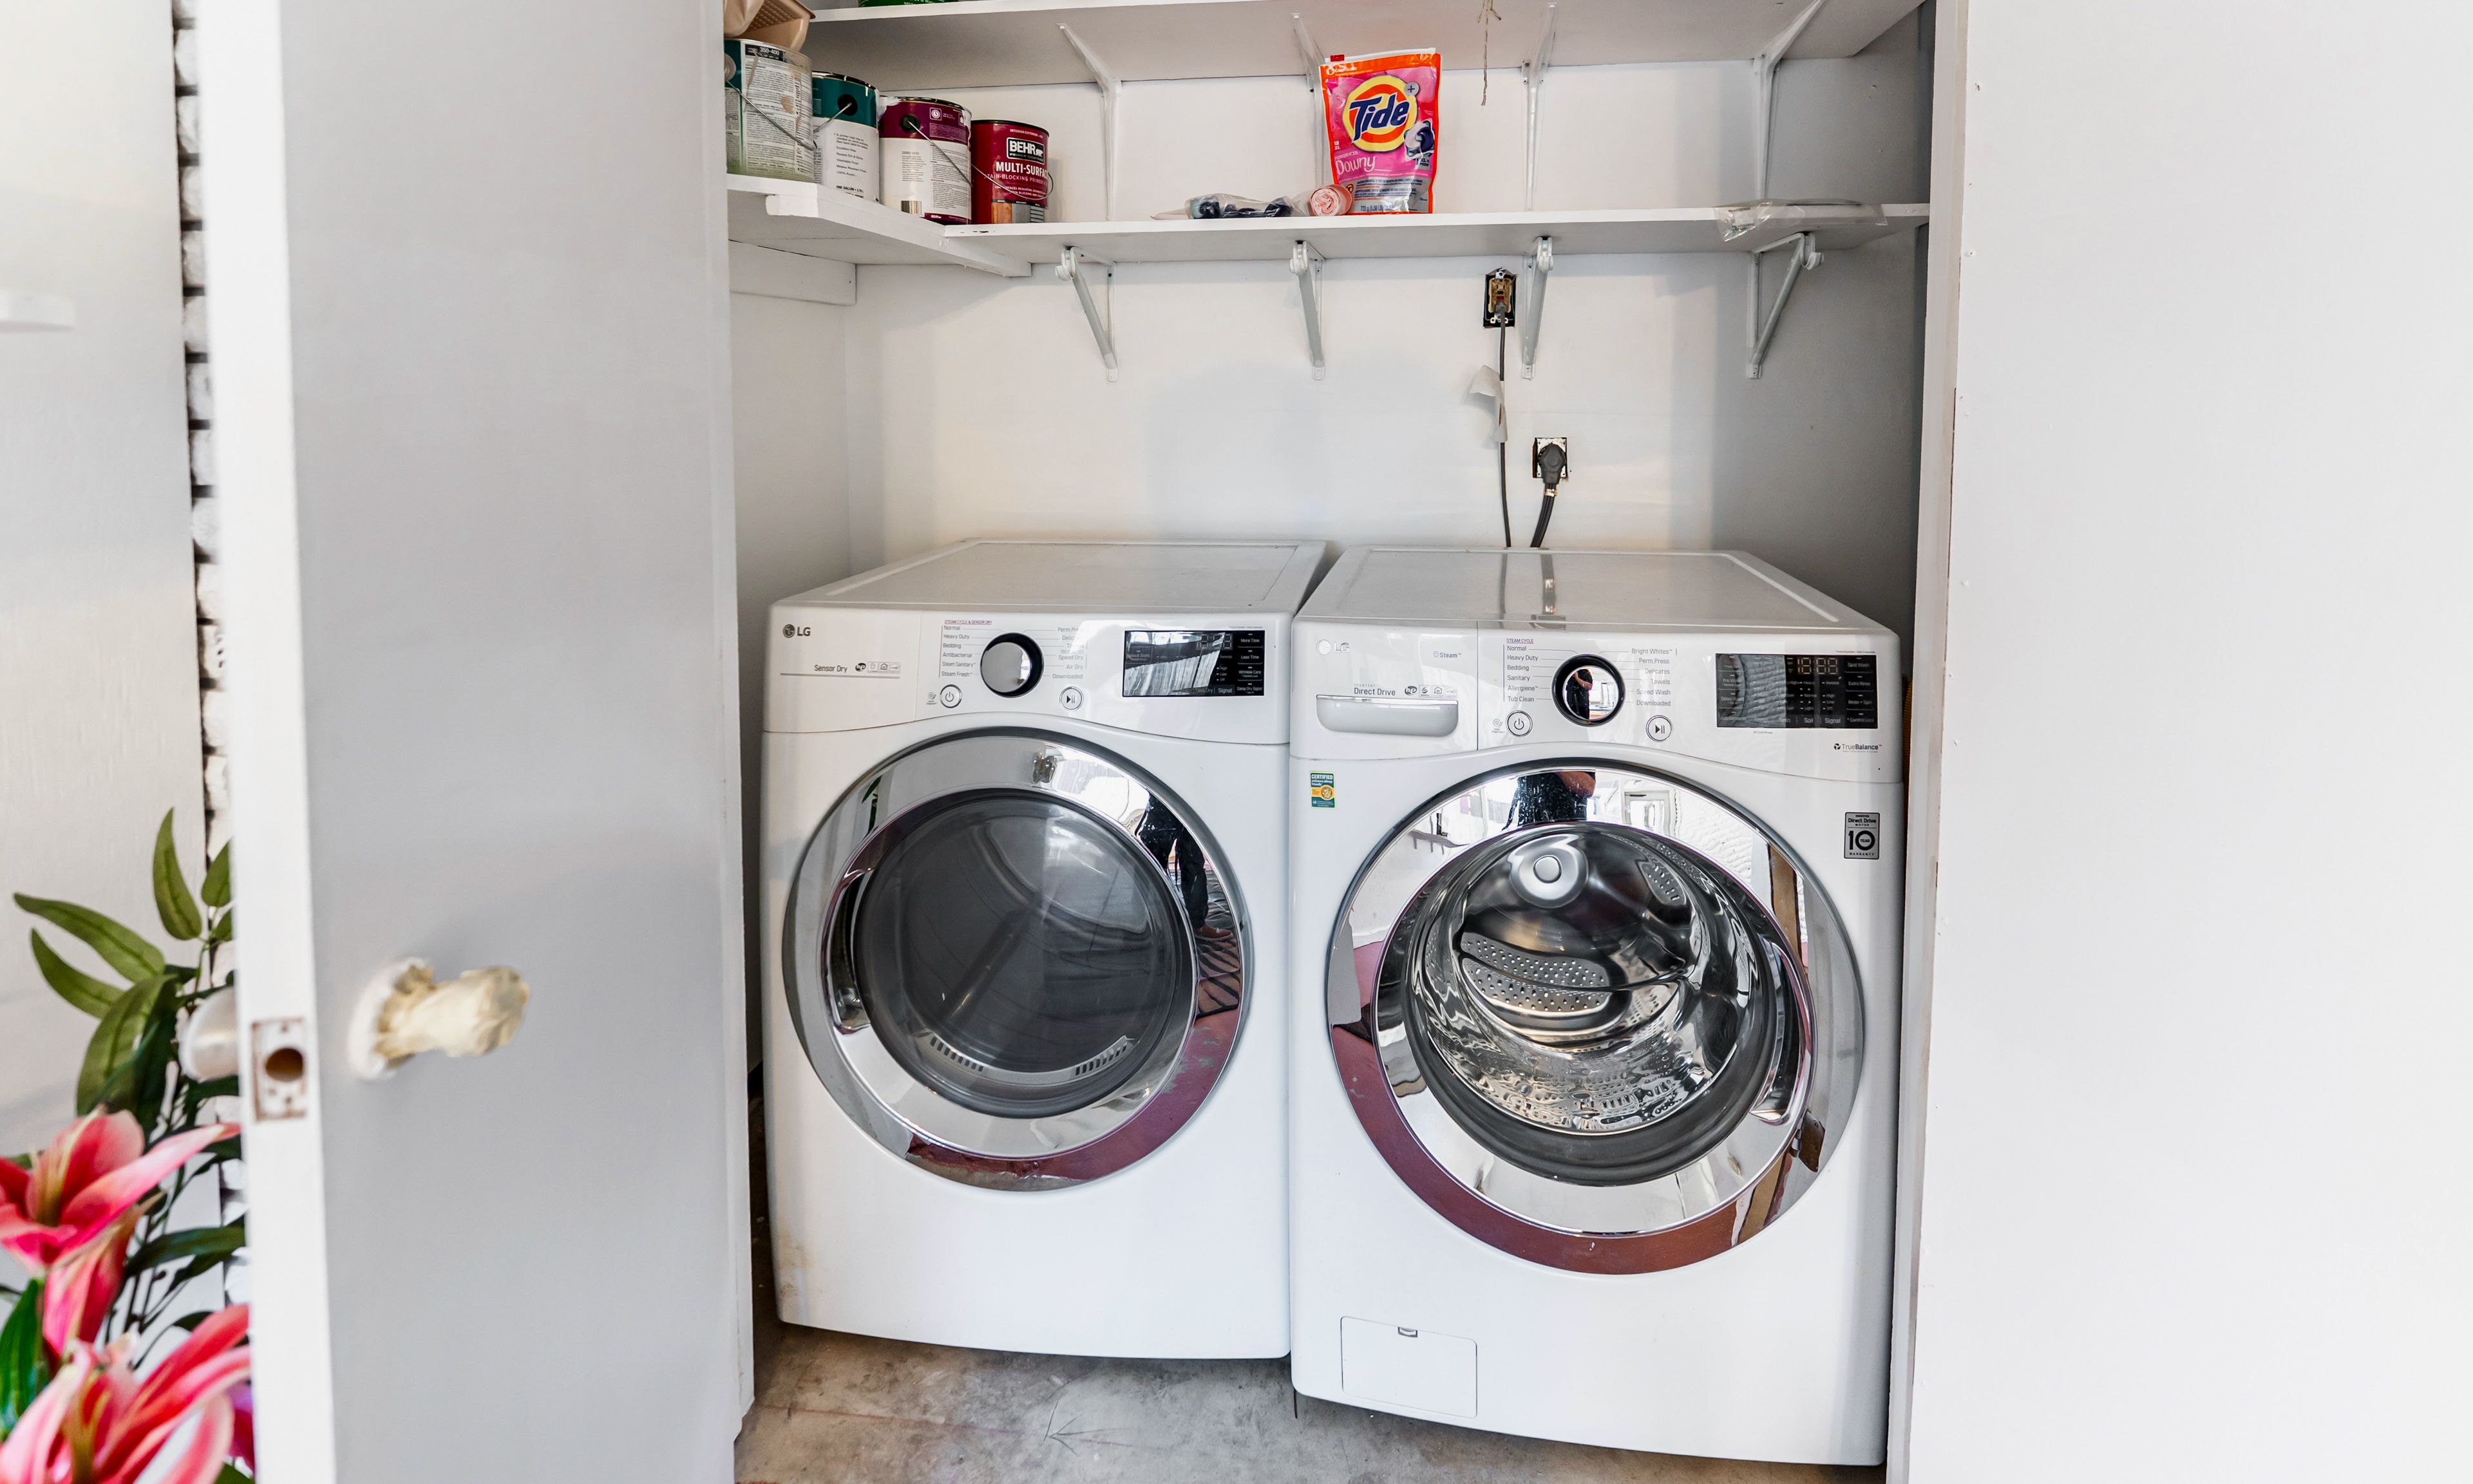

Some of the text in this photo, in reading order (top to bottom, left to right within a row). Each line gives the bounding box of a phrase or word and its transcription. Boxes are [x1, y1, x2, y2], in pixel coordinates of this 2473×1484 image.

[1349, 92, 1410, 141] Tide
[1009, 140, 1036, 155] BEHR
[996, 162, 1048, 180] MULTI-SURFAC
[1336, 156, 1376, 175] Downy
[797, 627, 810, 636] LG
[1334, 642, 1350, 653] LG
[836, 665, 848, 673] Dry
[1354, 687, 1375, 695] Direct
[1848, 830, 1875, 850] 10
